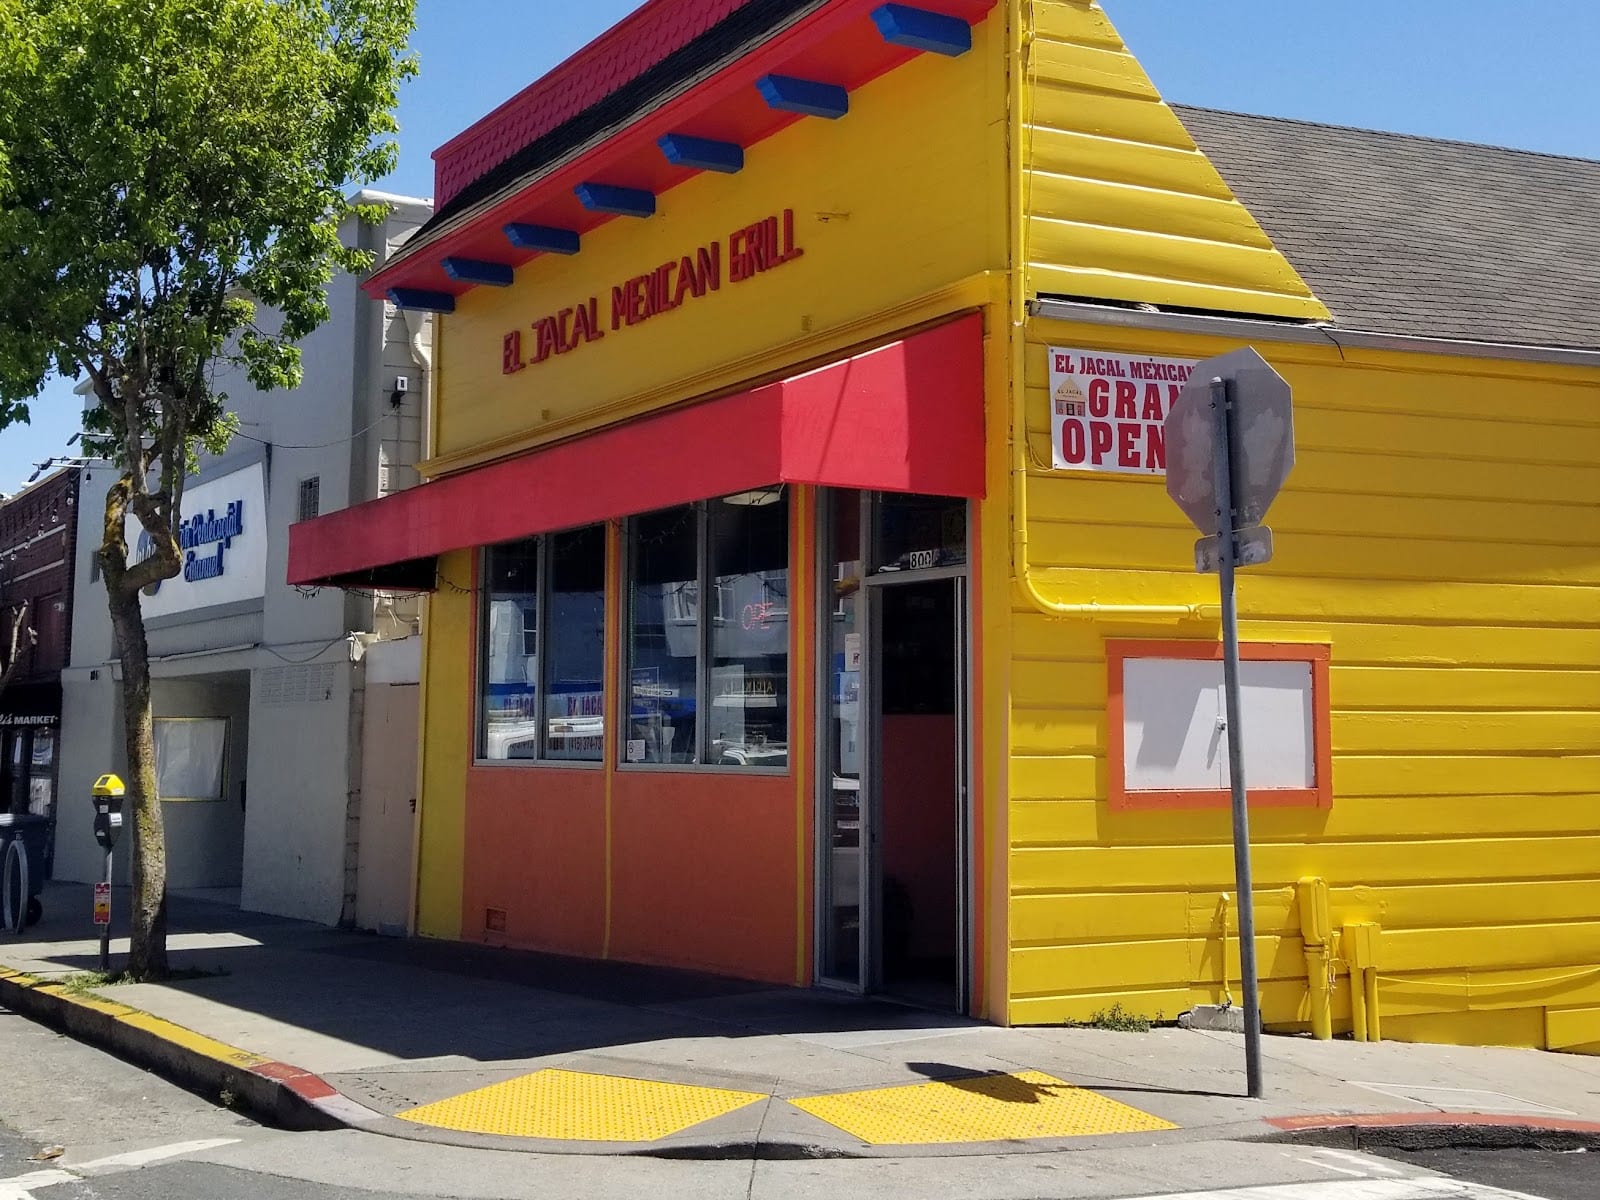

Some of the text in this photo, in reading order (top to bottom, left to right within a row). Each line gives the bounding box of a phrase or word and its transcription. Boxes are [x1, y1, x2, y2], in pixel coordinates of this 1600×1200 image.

[503, 209, 804, 374] EL JACAL MEXICAN GRILL
[1055, 355, 1074, 373] EL
[1079, 357, 1126, 378] JACAL
[911, 551, 931, 568] 800
[14, 715, 56, 725] MARKET
